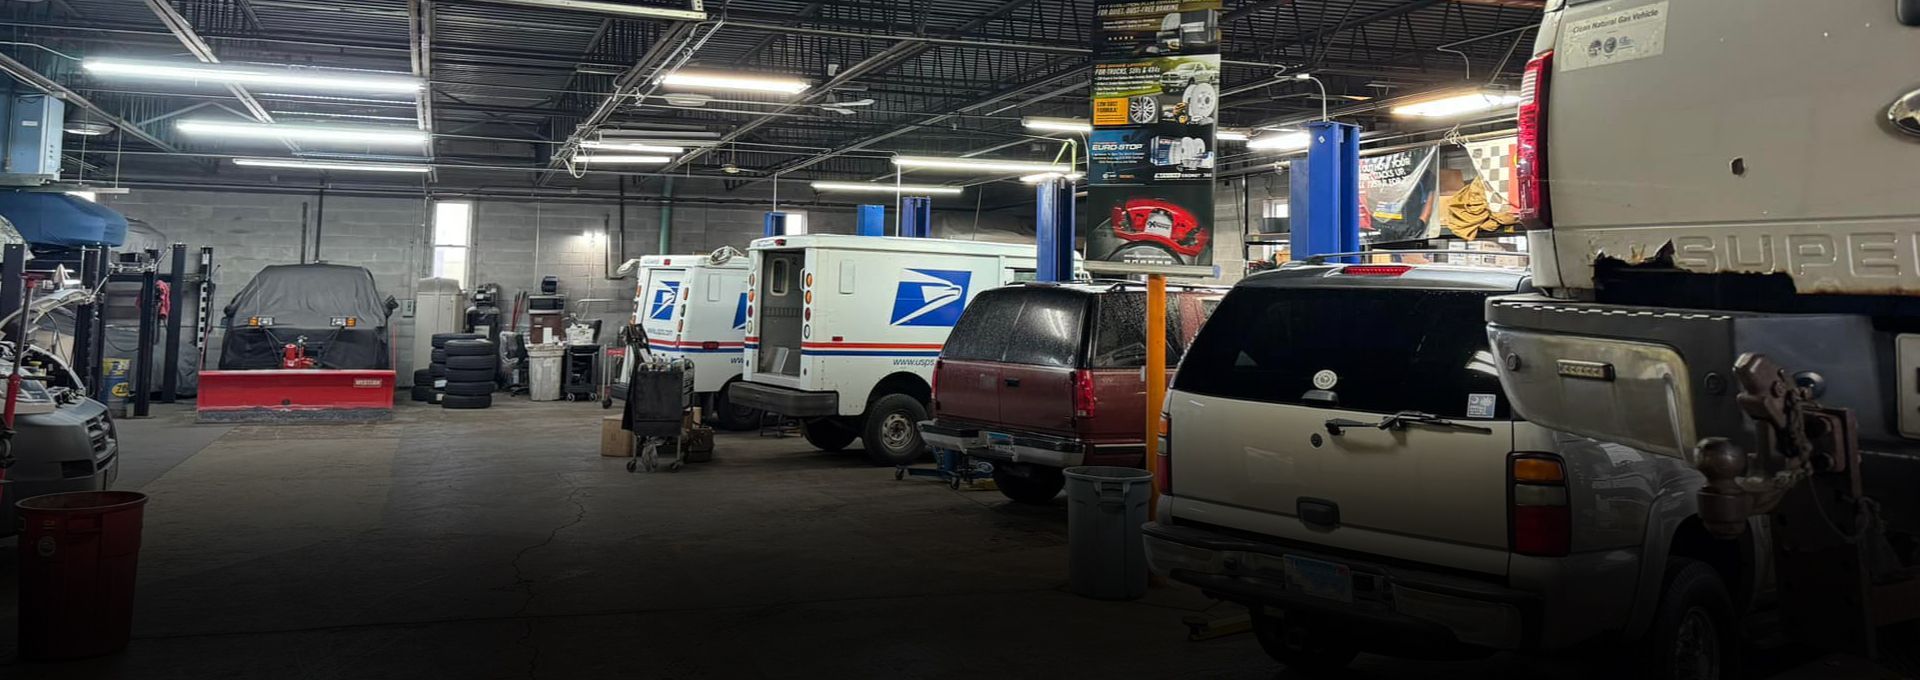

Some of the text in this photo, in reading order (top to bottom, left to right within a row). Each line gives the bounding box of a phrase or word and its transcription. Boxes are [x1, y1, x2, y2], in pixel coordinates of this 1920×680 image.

[1573, 9, 1659, 33] Clean Natural Gas Vehicle
[1391, 157, 1411, 168] YOUR
